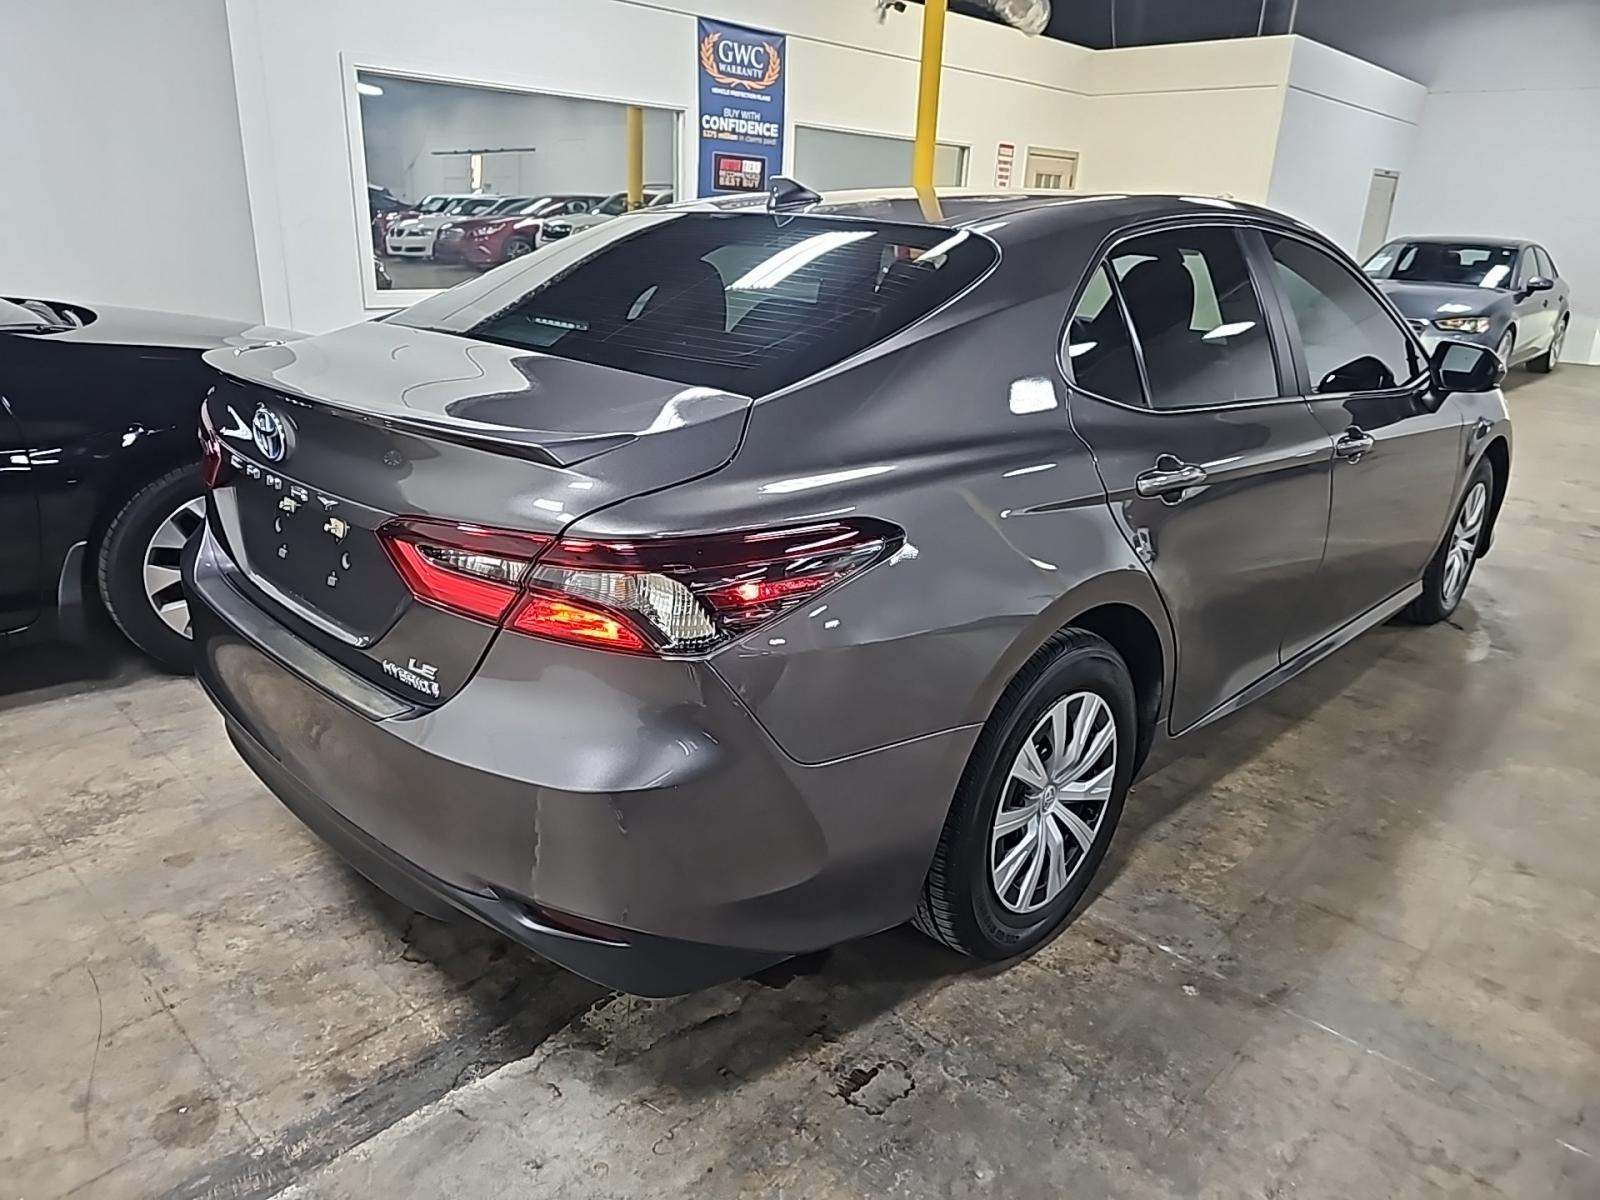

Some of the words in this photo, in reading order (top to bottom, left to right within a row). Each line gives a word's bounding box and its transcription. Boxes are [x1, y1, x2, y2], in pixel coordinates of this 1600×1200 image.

[718, 40, 764, 69] GWC
[719, 62, 763, 78] WARRANTY
[723, 107, 740, 118] BUY
[741, 109, 761, 121] WITH
[702, 114, 779, 138] CONFIDENCE
[408, 657, 438, 680] LE
